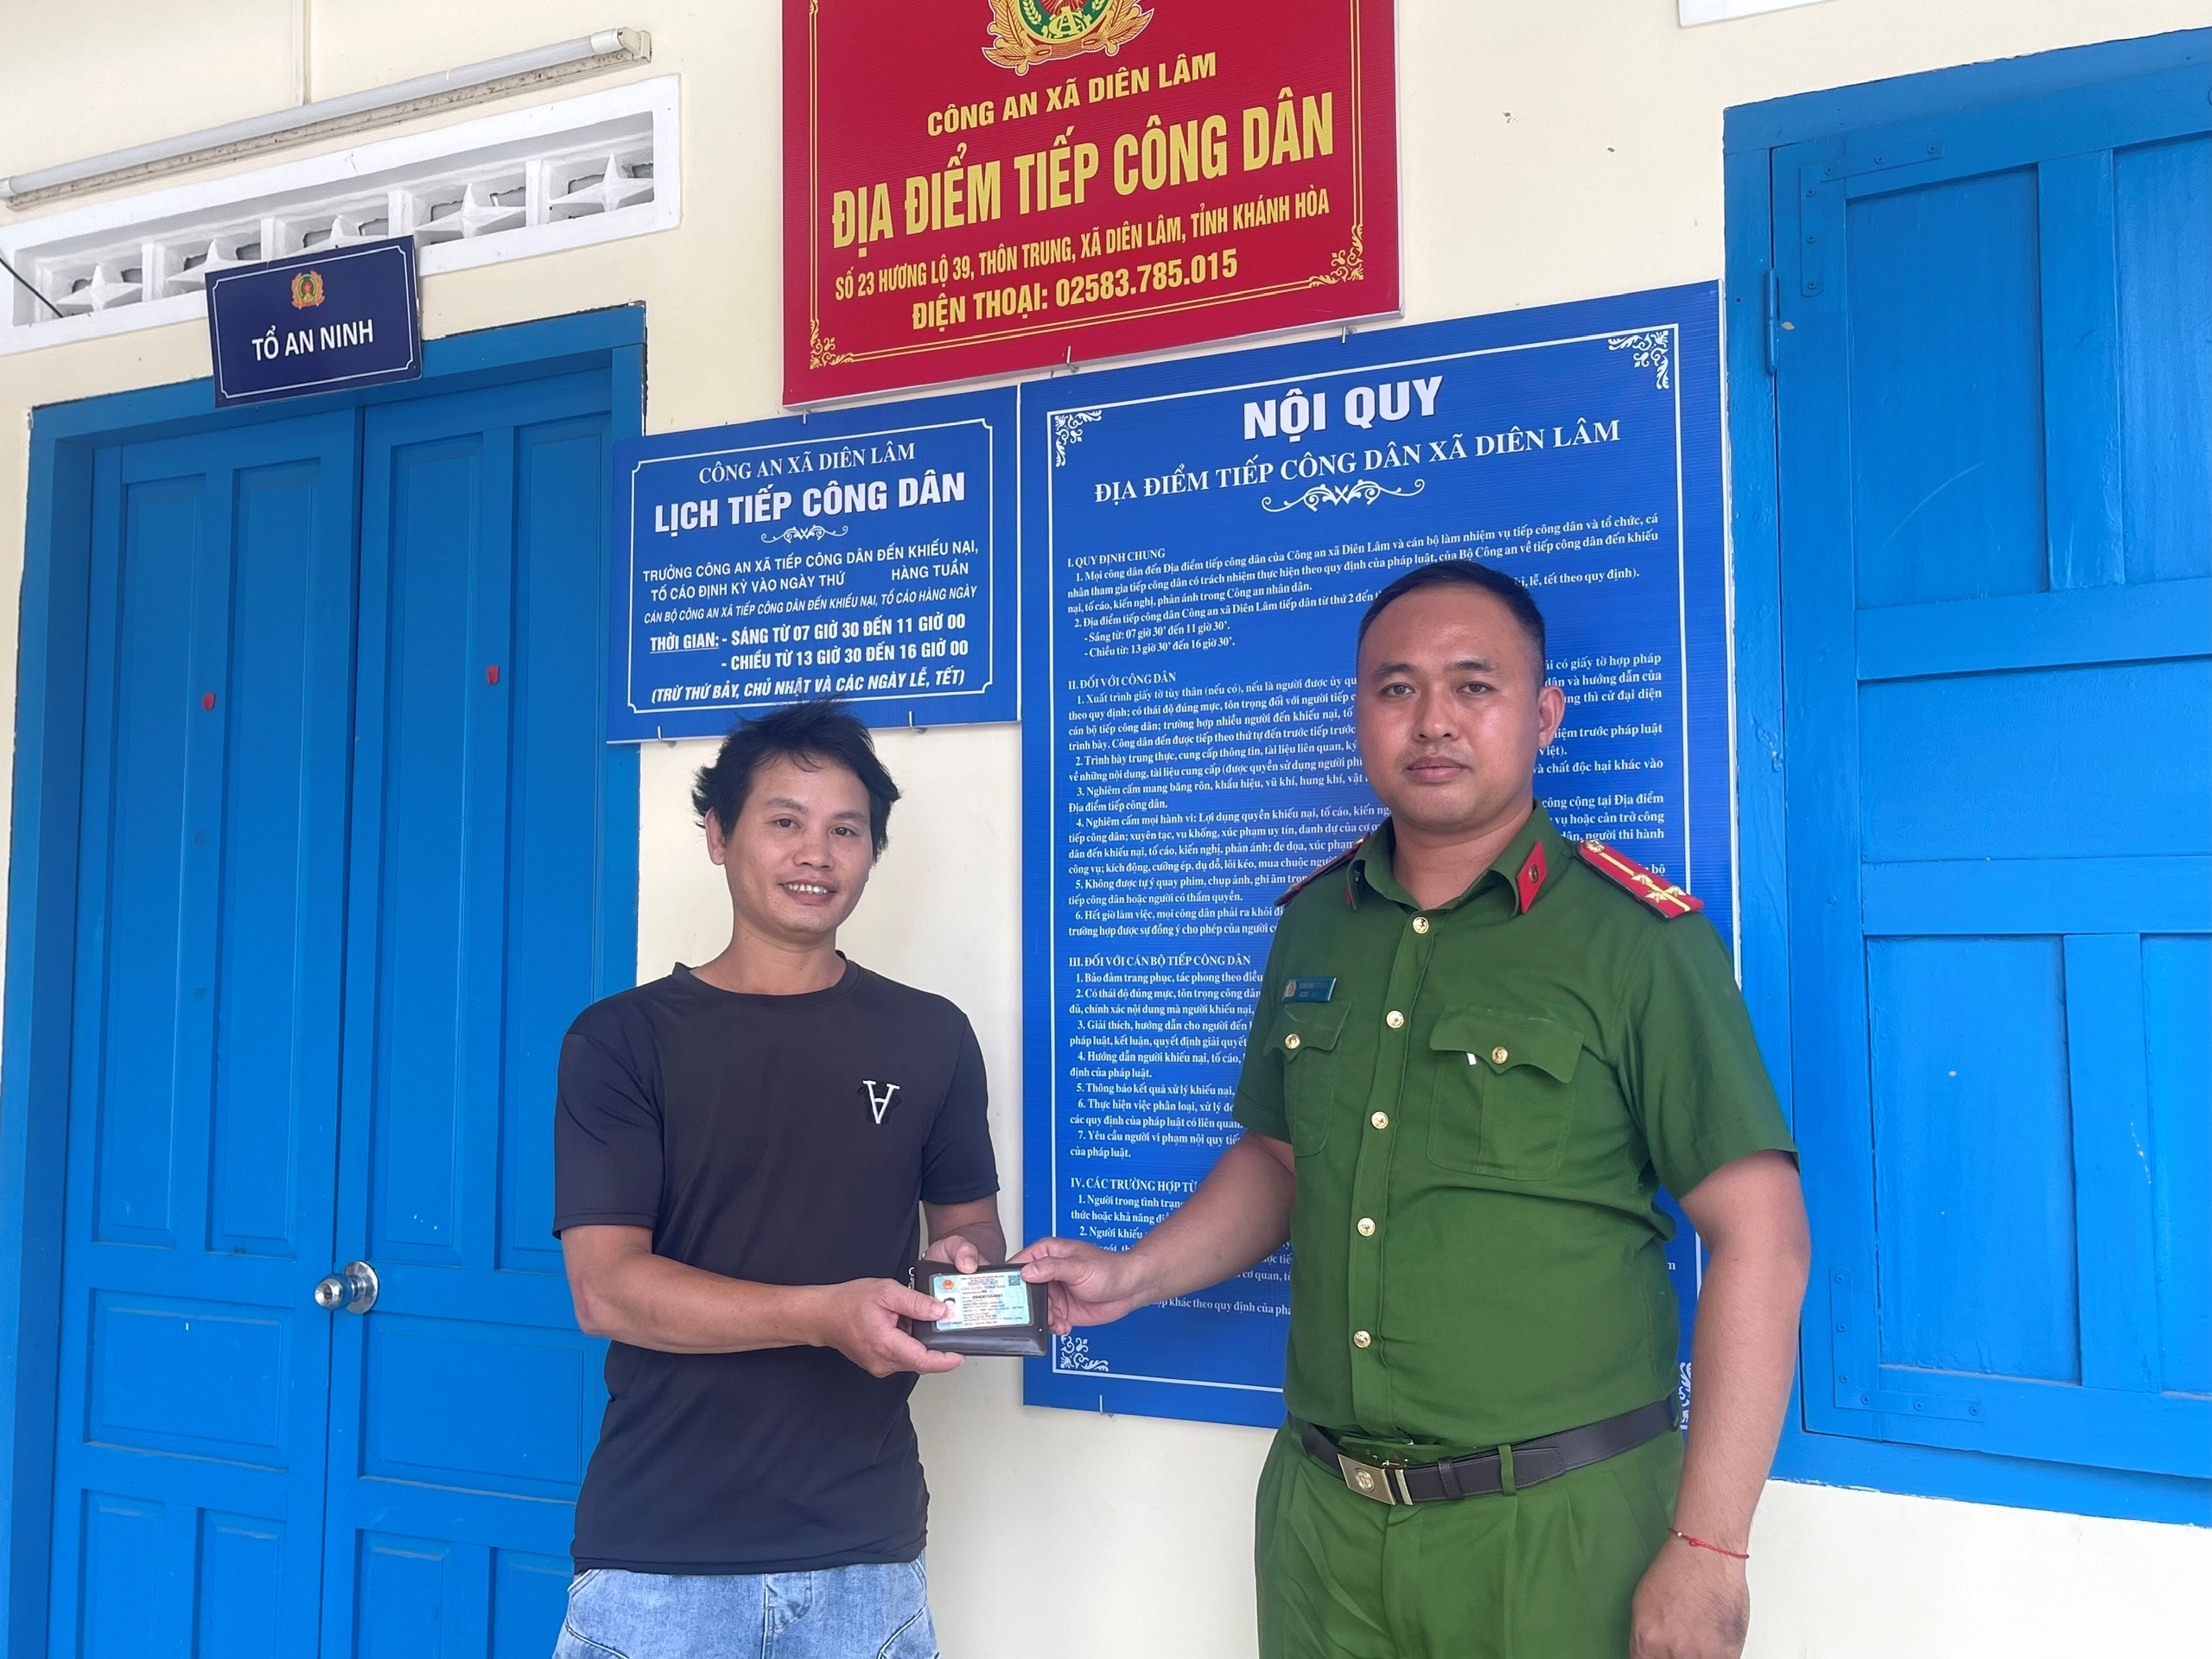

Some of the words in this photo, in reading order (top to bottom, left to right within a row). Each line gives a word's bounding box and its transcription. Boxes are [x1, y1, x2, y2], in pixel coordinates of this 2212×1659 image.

[927, 100, 995, 137] CÔNG
[1002, 91, 1038, 122] AN
[1046, 77, 1081, 112] XÃ
[1088, 66, 1150, 104] DIÊN
[1159, 51, 1216, 89] LÂM
[831, 182, 894, 258] ĐỊA
[904, 142, 1001, 235] ĐIỂM
[1014, 124, 1099, 215] TIẾP
[1114, 114, 1228, 196] CÔNG
[1243, 86, 1333, 172] DÂN
[835, 266, 855, 301] SỐ
[857, 271, 874, 297] 23
[879, 262, 927, 293] HƯƠNG
[931, 253, 949, 288] LỘ
[952, 255, 975, 281] 39,
[978, 243, 1018, 276] THÔN
[1021, 236, 1076, 269] TRUNG,
[1080, 226, 1102, 259] XÃ
[1106, 220, 1142, 254] DIÊN
[1147, 213, 1186, 246] LÂM,
[1190, 202, 1228, 238] TỈNH
[1233, 194, 1290, 231] KHÁNH
[1294, 184, 1330, 219] HÒA
[912, 292, 966, 333] ĐIỆN
[972, 283, 1048, 321] THOẠI:
[1056, 248, 1237, 307] 02583.785.015
[251, 325, 279, 361] TỔ
[284, 328, 315, 357] AN
[320, 319, 373, 351] NINH
[1243, 387, 1326, 443] NỘI
[1344, 375, 1443, 429] QUY
[698, 461, 753, 484] CÔNG
[756, 458, 783, 478] AN
[787, 450, 814, 474] XÃ
[818, 445, 866, 471] DIÊN
[870, 440, 915, 464] LÂM
[1094, 480, 1138, 505] ĐỊA
[1143, 462, 1210, 497] ĐIỂM
[1215, 454, 1274, 488] TIẾP
[1281, 451, 1357, 480] CÔNG
[1363, 441, 1421, 471] DÂN
[1428, 433, 1468, 462] XÃ
[1475, 425, 1545, 457] DIÊN
[1553, 416, 1620, 448] LÂM
[655, 499, 718, 537] LỊCH
[728, 483, 792, 525] TIẾP
[802, 480, 887, 518] CÔNG
[899, 468, 965, 508] DÂN
[642, 563, 692, 582] TRƯỞNG
[696, 562, 731, 577] CÔNG
[734, 561, 751, 575] AN
[754, 556, 772, 572] XÃ
[774, 552, 803, 570] TIẾP
[805, 551, 842, 568] CÔNG
[846, 547, 873, 564] DÂN
[876, 546, 904, 562] ĐẾN
[908, 542, 949, 558] KHIẾU
[952, 539, 978, 556] NẠI,
[651, 583, 668, 601] TỐ
[670, 583, 696, 601] CÁO
[698, 582, 728, 600] ĐỊNH
[731, 578, 748, 595] KỲ
[751, 576, 778, 594] VÀO
[780, 573, 816, 590] NGÀY
[818, 569, 846, 587] THỨ
[891, 564, 929, 582] HÀNG
[932, 557, 969, 577] TUẦN
[1075, 555, 1098, 569] QUY
[1098, 552, 1126, 566] ĐỊNH
[1127, 548, 1166, 562] CHUNG
[1530, 575, 1542, 587] lễ,
[1543, 575, 1558, 585] tết
[1559, 573, 1583, 584] theo
[1584, 572, 1605, 584] quy
[1606, 567, 1640, 582] định).
[644, 610, 663, 625] CÁN
[664, 607, 678, 624] BỘ
[678, 607, 705, 621] CÔNG
[705, 607, 720, 619] AN
[720, 603, 734, 618] XÃ
[735, 600, 756, 617] TIẾP
[757, 600, 785, 615] CÔNG
[785, 597, 806, 613] DÂN
[807, 594, 828, 611] ĐẾN
[829, 592, 859, 609] KHIẾU
[859, 594, 878, 608] NẠI,
[880, 588, 895, 605] TỐ
[895, 588, 917, 604] CÁO
[918, 586, 947, 602] HÀNG
[949, 583, 977, 600] NGÀY
[650, 632, 679, 652] THỜI
[683, 632, 720, 650] GIAN:
[731, 626, 769, 646] SÁNG
[772, 623, 791, 643] TỪ
[792, 625, 810, 642] 07
[814, 619, 839, 640] GIỜ
[842, 621, 860, 639] 30
[862, 614, 893, 637] ĐẾN
[896, 617, 912, 633] 11
[918, 611, 944, 632] GIỜ
[947, 613, 966, 630] 00
[774, 648, 794, 668] TỪ
[796, 650, 813, 666] 13
[817, 645, 842, 665] GIỜ
[844, 647, 862, 664] 30
[865, 640, 895, 662] ĐẾN
[899, 643, 917, 659] 16
[921, 637, 947, 658] GIỜ
[950, 639, 969, 657] 00
[1555, 658, 1568, 670] có
[1570, 657, 1592, 671] giấy
[1595, 656, 1607, 667] tờ
[1609, 655, 1630, 668] hợp
[1632, 652, 1662, 667] pháp
[651, 684, 684, 704] (TRỪ
[684, 683, 712, 701] THỨ
[711, 679, 741, 699] BẢY,
[743, 677, 772, 697] CHỦ
[773, 677, 812, 697] NHẬT
[815, 674, 831, 693] VÀ
[836, 673, 865, 692] CÁC
[867, 671, 907, 690] NGÀY
[909, 666, 930, 689] LỄ,
[935, 664, 965, 686] TẾT)
[1079, 675, 1099, 690] ĐỐI
[1100, 674, 1120, 687] VỚI
[1121, 672, 1152, 686] CÔNG
[1154, 670, 1176, 683] DÂN
[1068, 802, 1084, 815] Địa
[1084, 798, 1107, 812] điểm
[1108, 798, 1125, 813] tiếp
[1125, 799, 1147, 812] công
[1147, 798, 1168, 810] dân.
[1084, 953, 1104, 967] ĐỐI
[1105, 954, 1125, 967] VỚI
[1126, 954, 1149, 967] CÁN
[1150, 953, 1166, 969] BỘ
[1166, 952, 1192, 966] TIẾP
[1193, 952, 1226, 966] CÔNG
[1227, 952, 1251, 966] DÂN
[1069, 1066, 1090, 1079] định
[1090, 1066, 1107, 1077] của
[1108, 1067, 1131, 1080] pháp
[1131, 1067, 1153, 1080] luật.
[1070, 1146, 1086, 1156] của
[1087, 1147, 1110, 1160] pháp
[1110, 1147, 1131, 1160] luật.
[1085, 1176, 1109, 1189] CÁC
[1109, 1177, 1155, 1192] TRƯỜNG
[1157, 1179, 1181, 1194] HỢP
